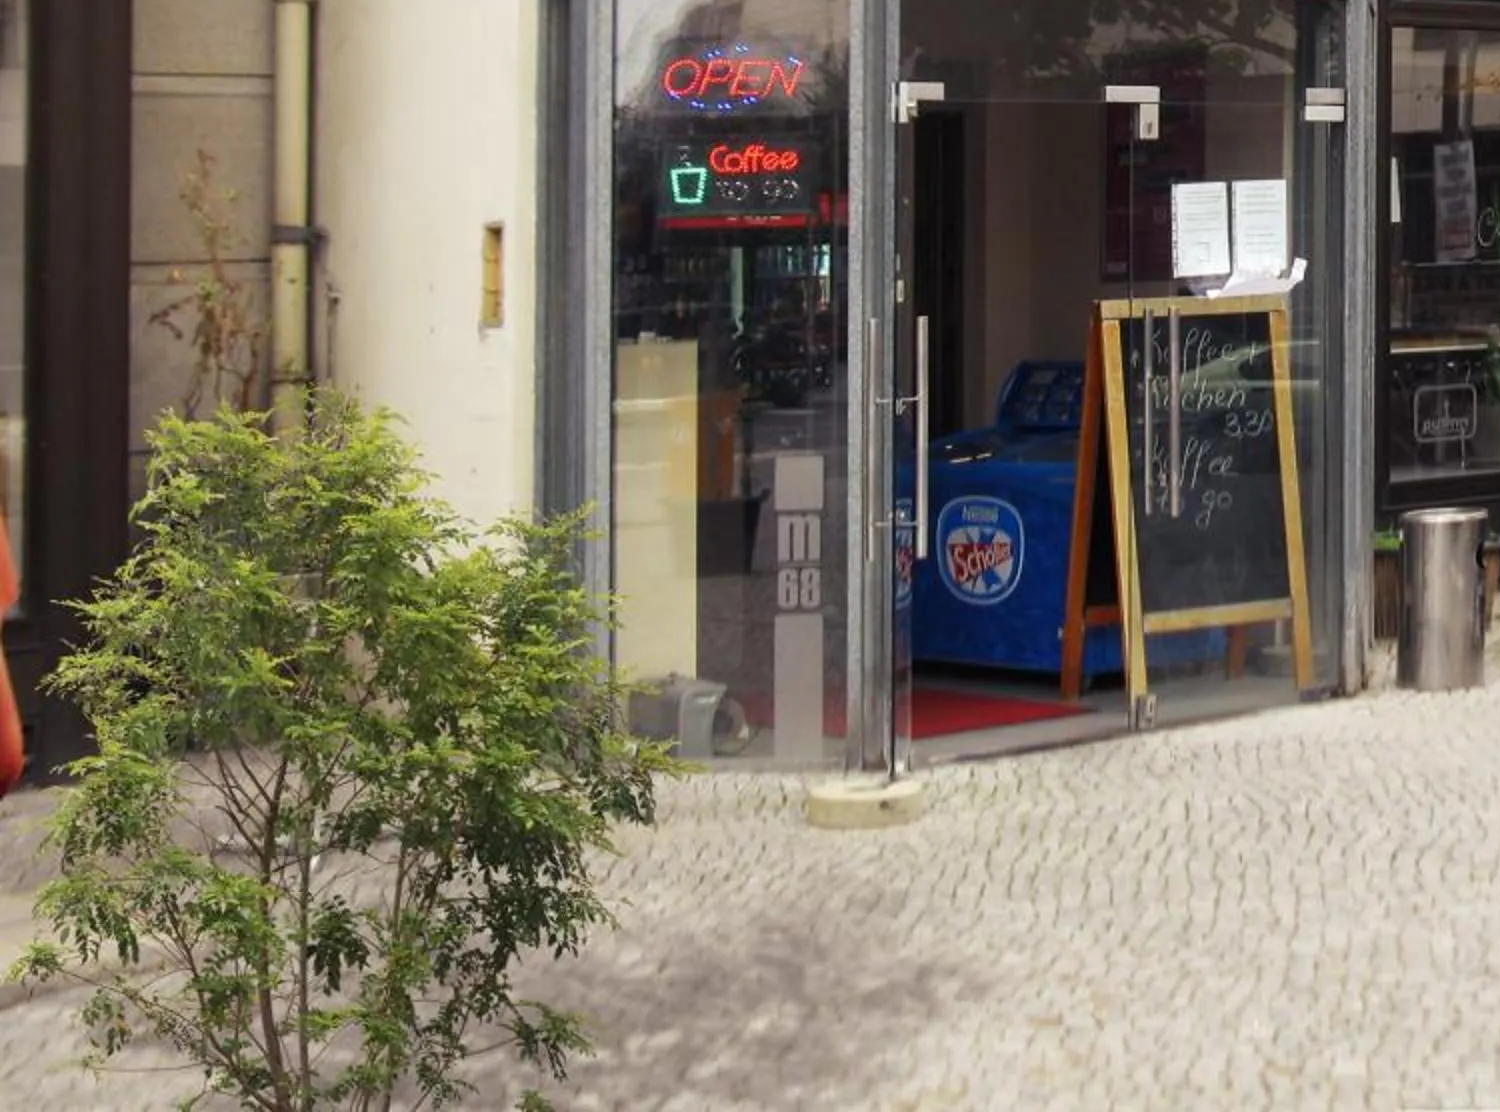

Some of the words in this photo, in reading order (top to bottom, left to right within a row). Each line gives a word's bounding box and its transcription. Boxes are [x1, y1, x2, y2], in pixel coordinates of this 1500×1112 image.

[664, 57, 803, 98] OPEN
[709, 143, 800, 174] Coffee
[777, 567, 821, 610] 68
